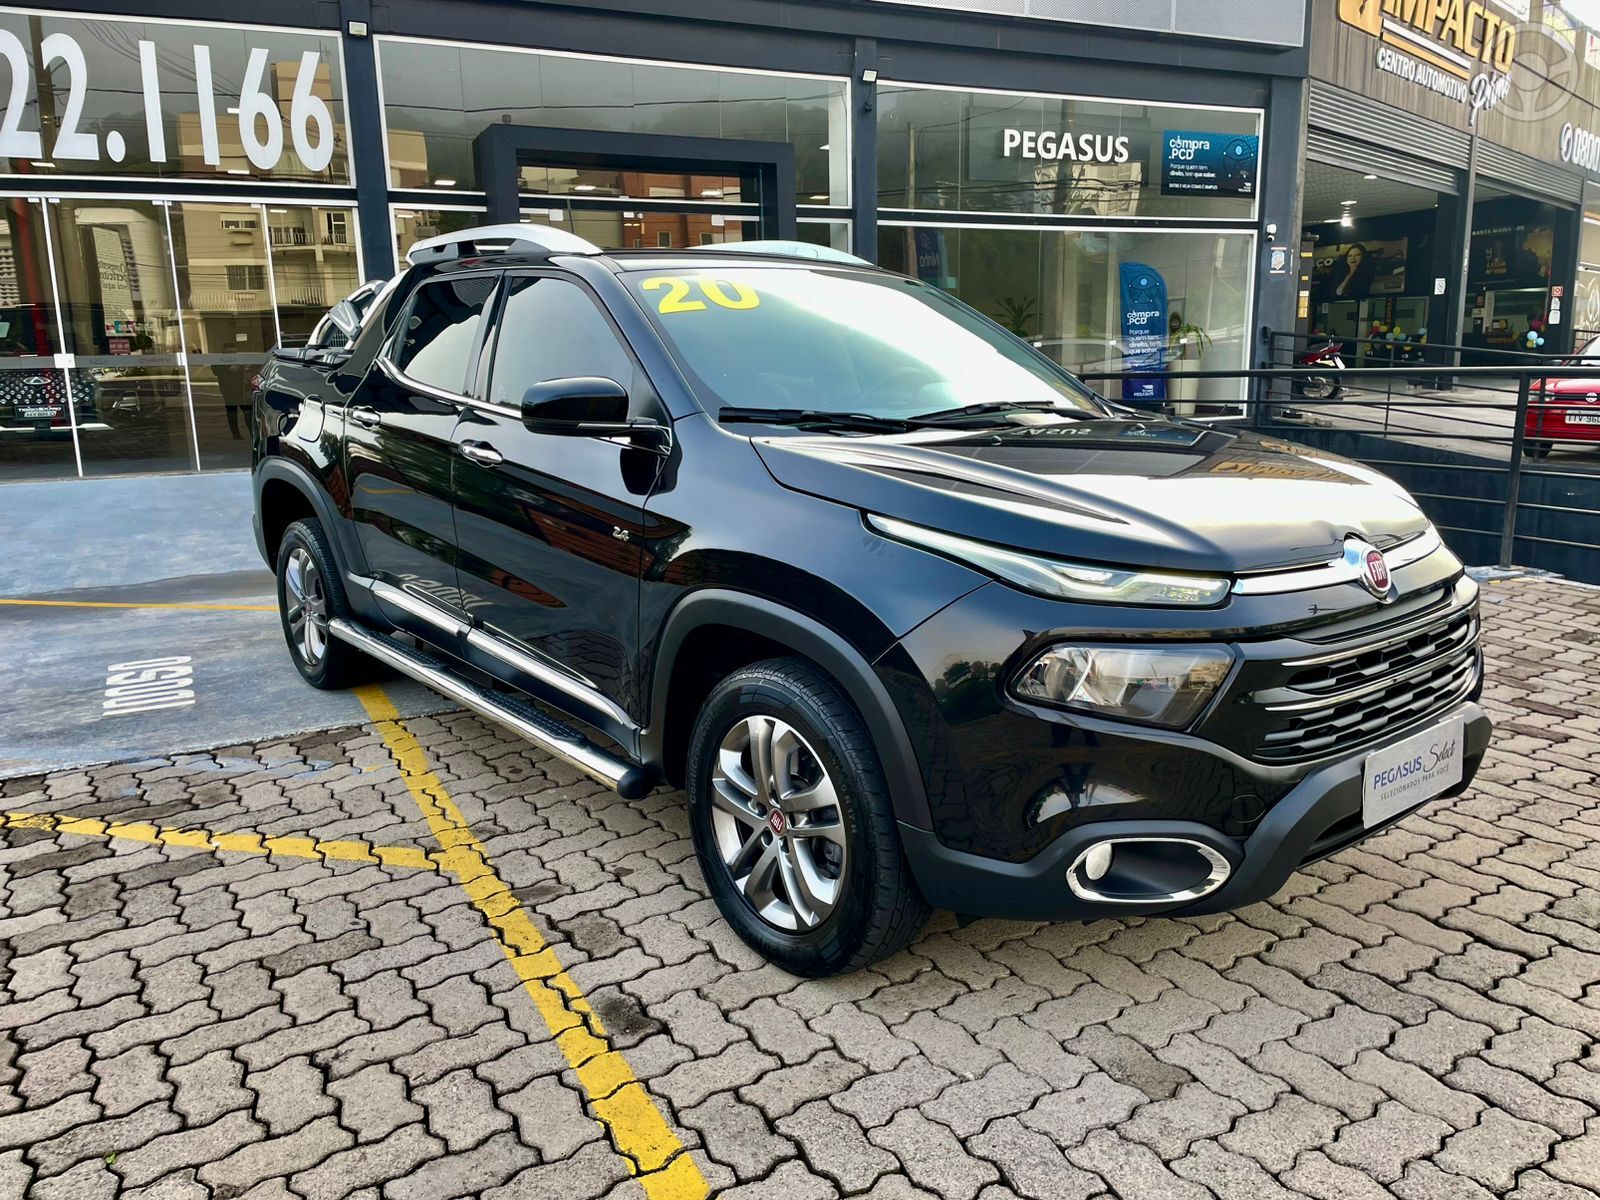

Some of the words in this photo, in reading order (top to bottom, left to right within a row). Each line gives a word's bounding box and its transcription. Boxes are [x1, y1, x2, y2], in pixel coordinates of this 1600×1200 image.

[1383, 0, 1516, 73] PACTO
[1377, 47, 1415, 82] CENTRO
[1415, 64, 1468, 103] AUTOMOTIVO
[0, 29, 334, 172] 22.1166
[1003, 128, 1129, 163] PEGASUS
[1169, 136, 1210, 151] compra
[642, 276, 760, 314] 20
[1127, 310, 1159, 319] compra
[102, 656, 196, 716] IDOSO
[1373, 756, 1422, 790] PEGASUS
[1380, 780, 1420, 800] SELECIONADOS
[1421, 772, 1435, 782] PARA
